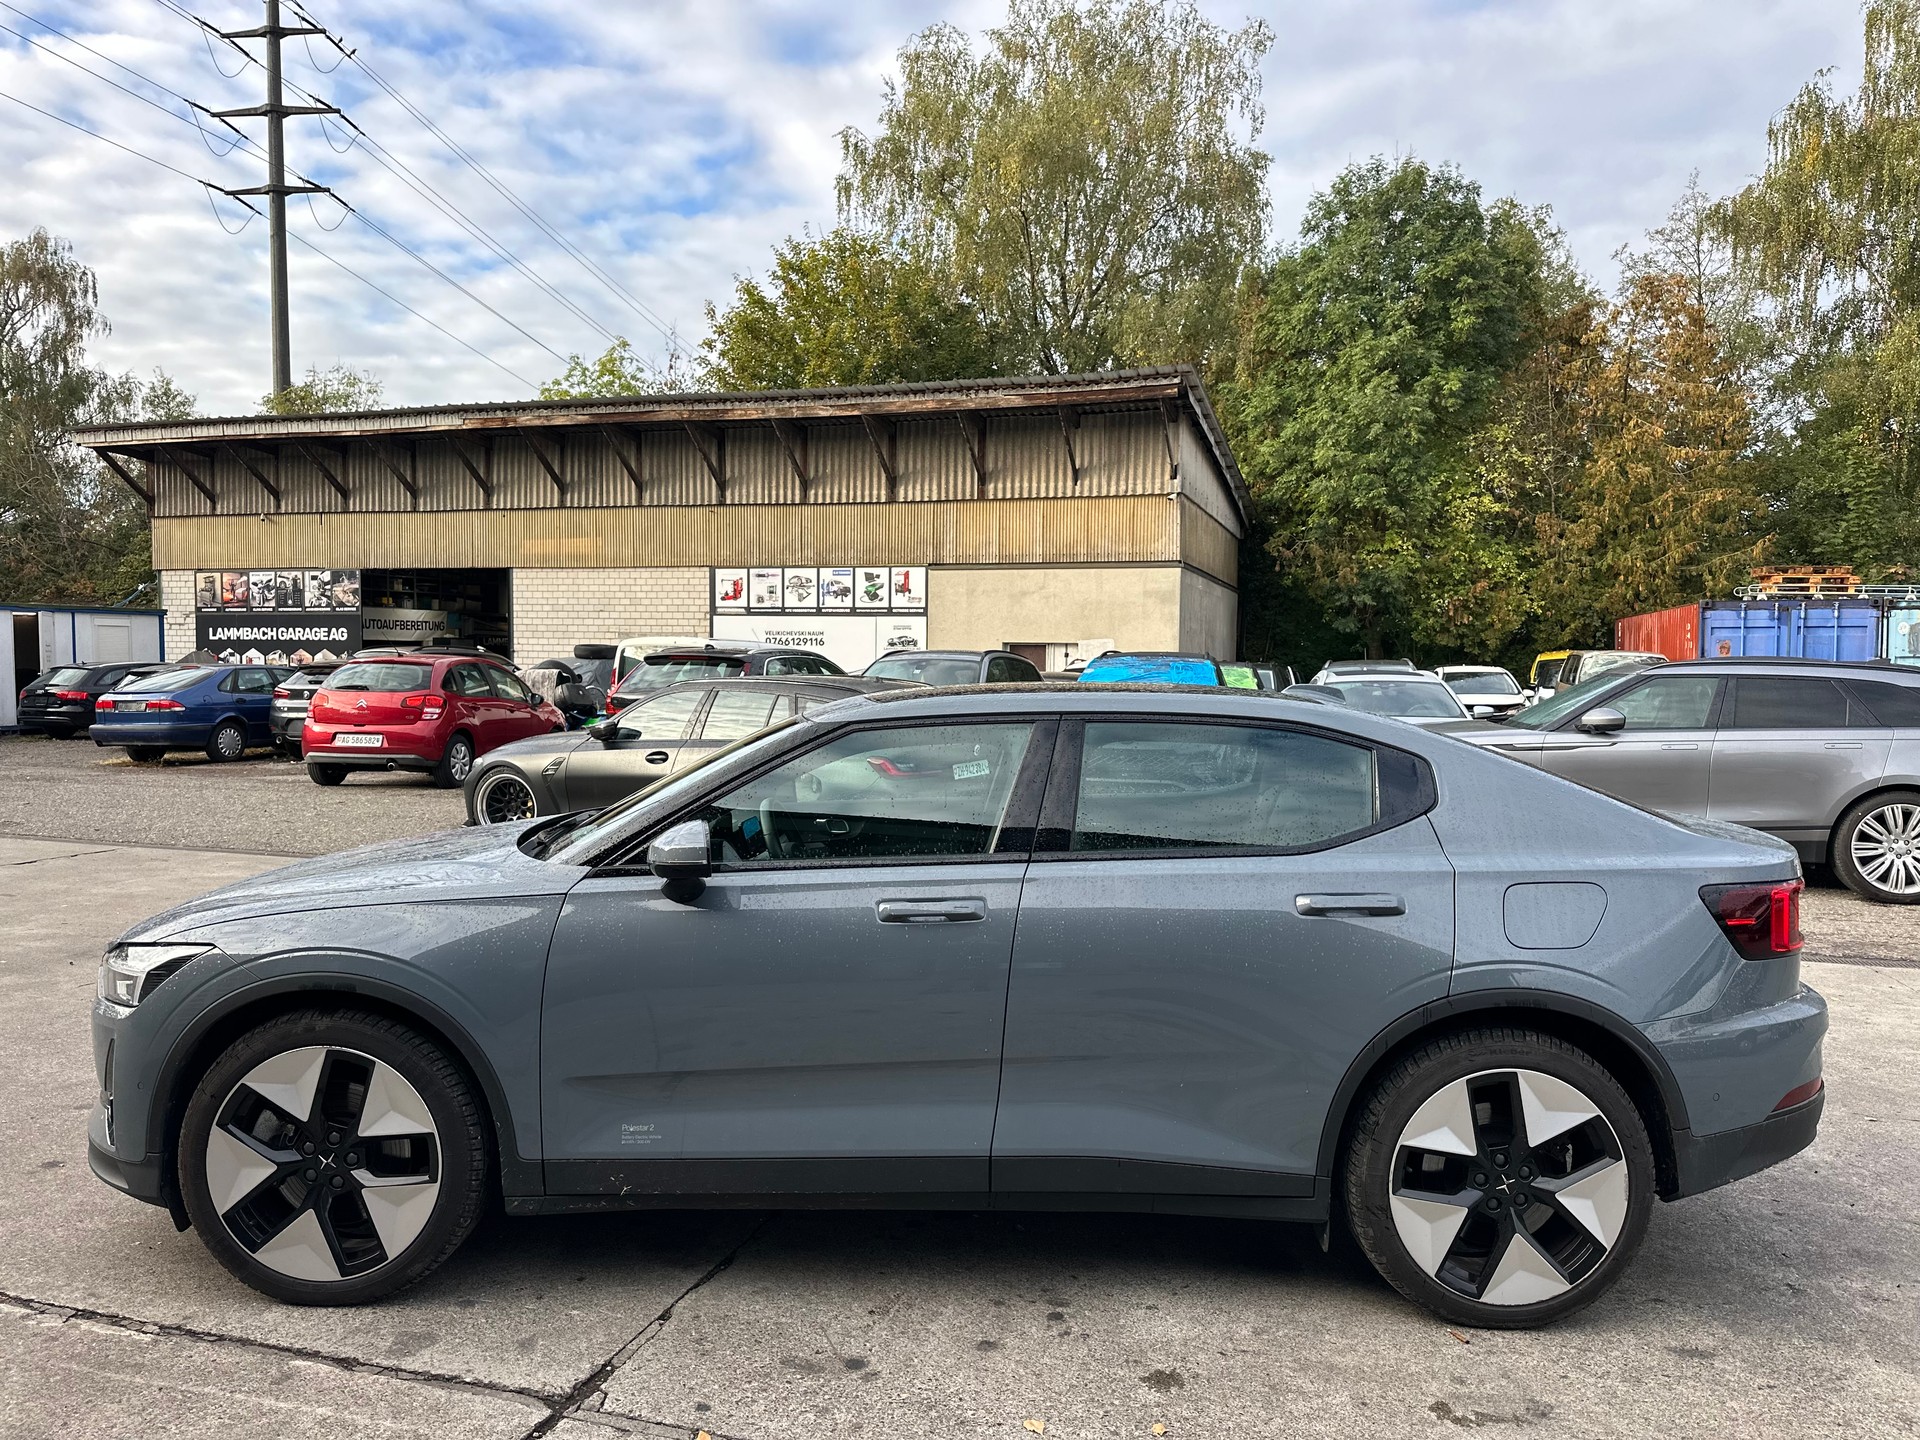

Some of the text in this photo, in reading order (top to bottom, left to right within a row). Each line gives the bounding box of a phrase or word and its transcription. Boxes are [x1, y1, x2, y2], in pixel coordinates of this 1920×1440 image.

[208, 627, 348, 640] LAMMBACH GARAGE AG
[765, 637, 825, 646] 0766129116
[341, 736, 376, 744] AG 586582
